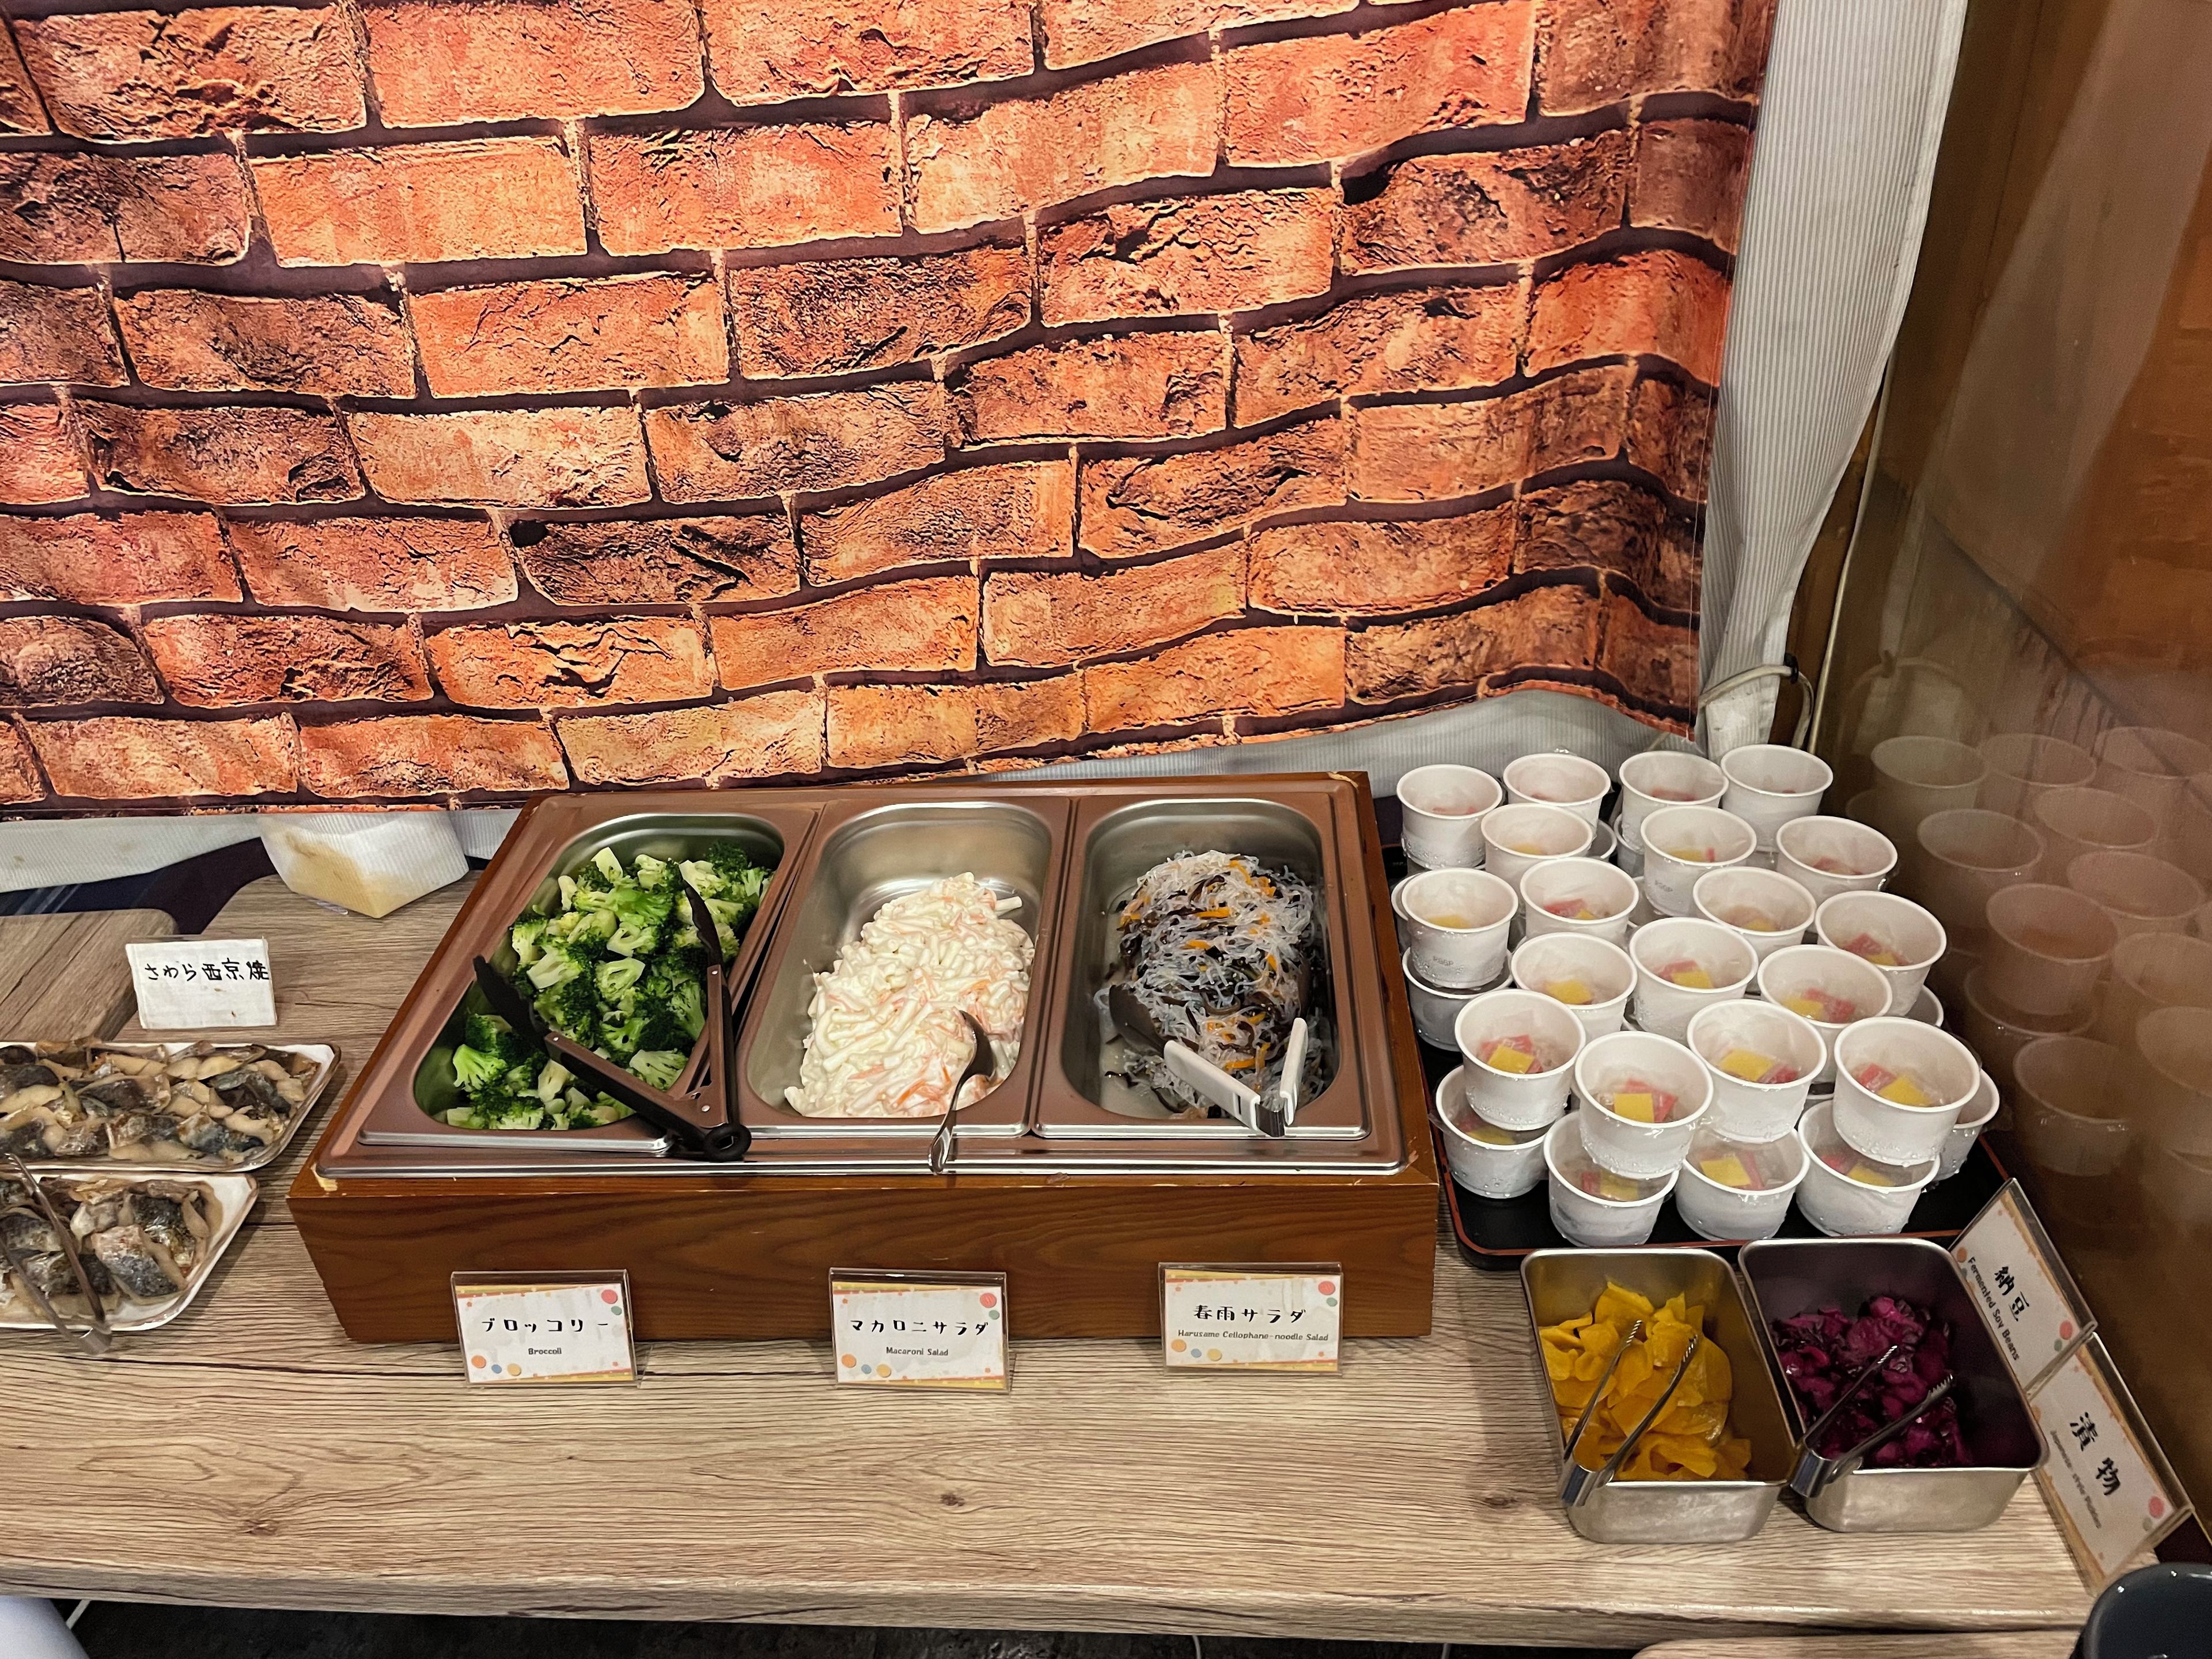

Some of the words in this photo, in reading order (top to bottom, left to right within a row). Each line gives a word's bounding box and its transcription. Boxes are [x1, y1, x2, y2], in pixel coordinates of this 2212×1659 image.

[145, 957, 270, 981] さわら西京焼
[1994, 1266, 2029, 1322] 納豆
[1194, 1304, 1306, 1324] 春雨サラダ
[1968, 1256, 1996, 1310] Fermented
[1992, 1308, 2005, 1330] Soy
[2002, 1328, 2020, 1361] Beans
[481, 1317, 609, 1333] ブロッコリー
[850, 1319, 989, 1336] マカロニサラダ
[1177, 1329, 1220, 1338] Harusame
[1305, 1333, 1329, 1342] Salad
[528, 1347, 562, 1355] Broccoli
[886, 1346, 925, 1356] Macaroni
[927, 1348, 949, 1357] Salad
[2069, 1411, 2122, 1497] 漬物
